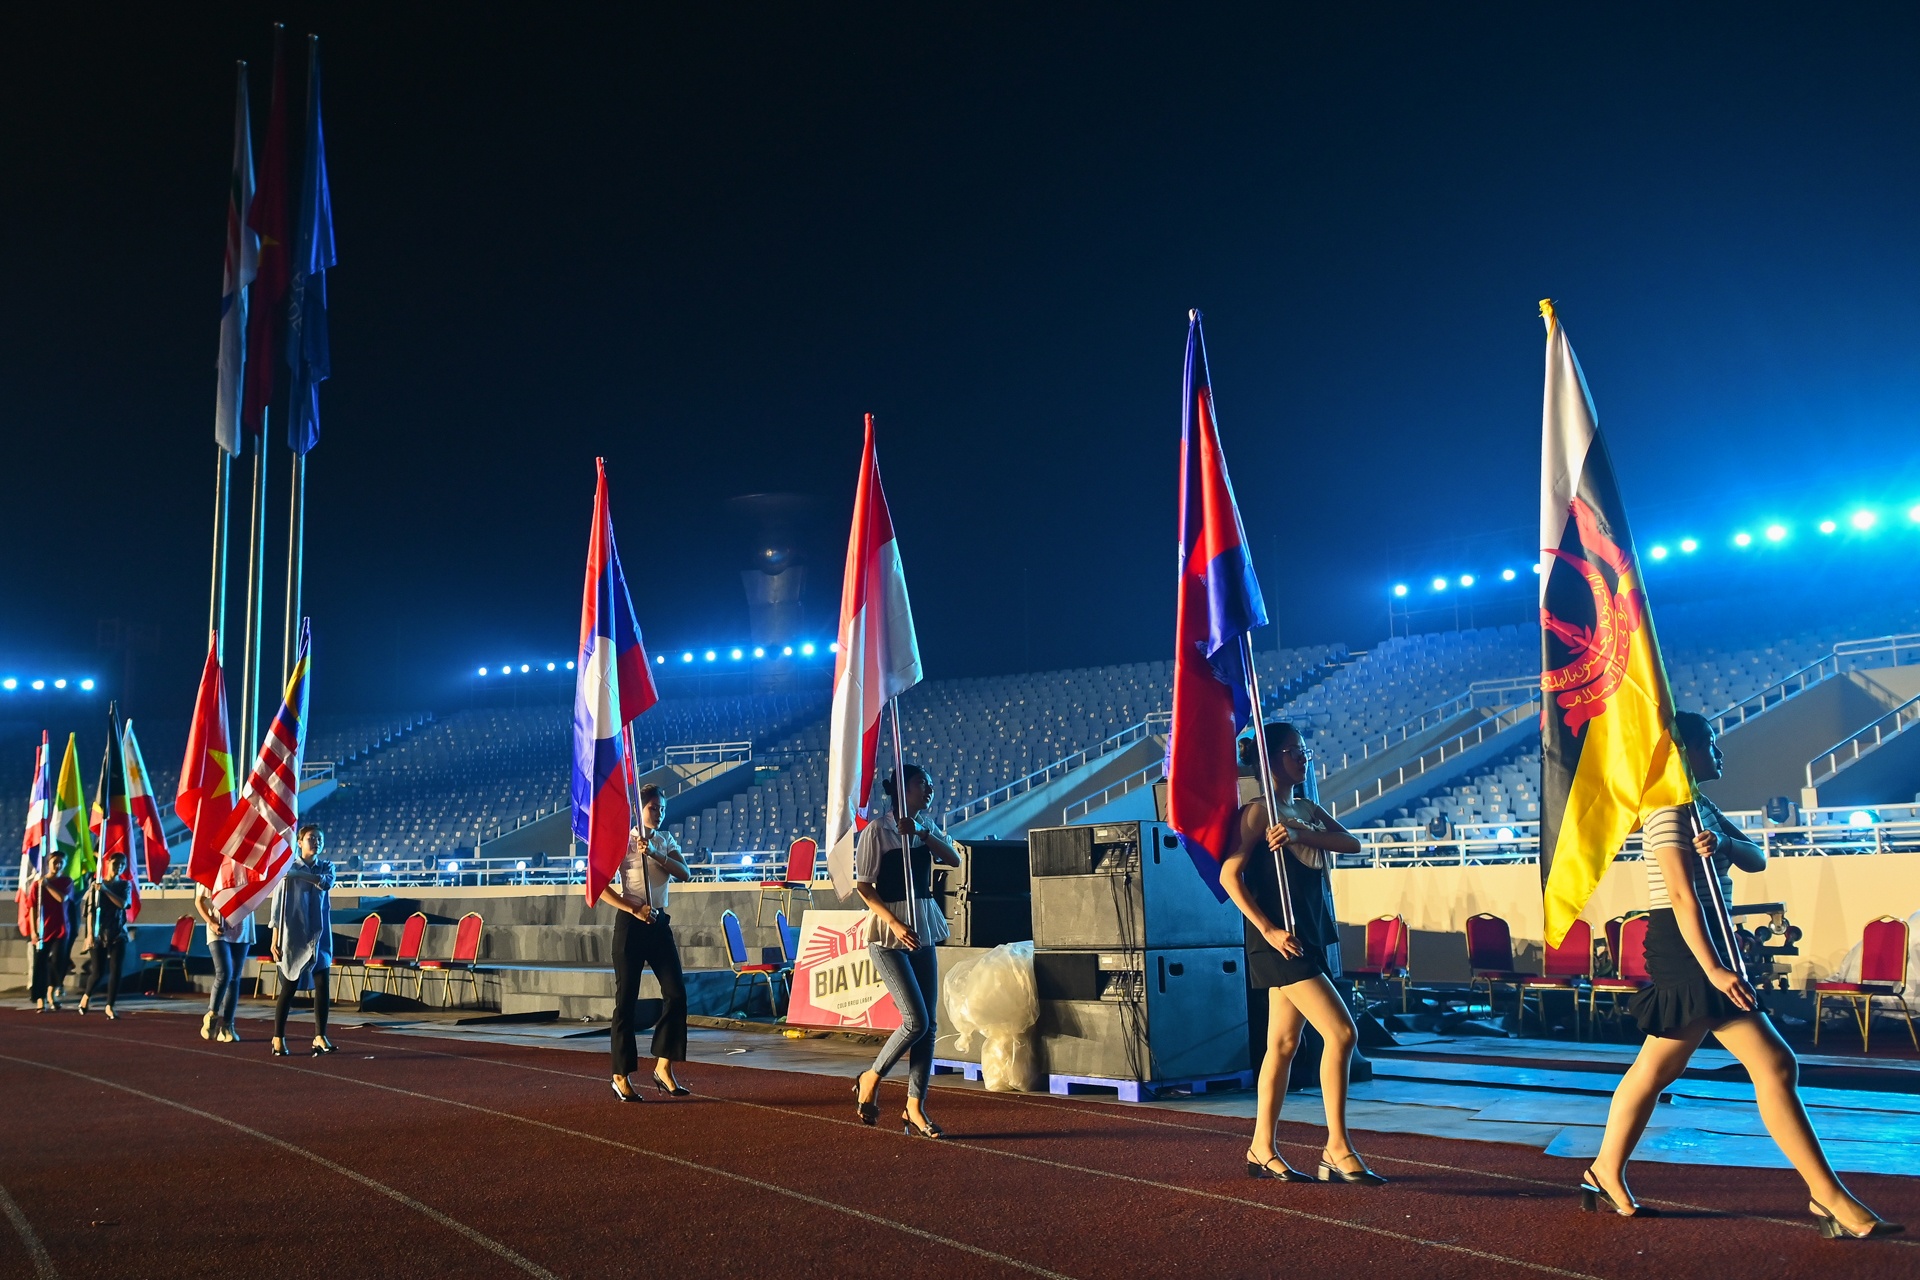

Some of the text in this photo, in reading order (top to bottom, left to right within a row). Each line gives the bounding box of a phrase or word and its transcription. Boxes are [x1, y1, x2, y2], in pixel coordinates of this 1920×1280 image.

[815, 964, 849, 998] BIA
[837, 1001, 847, 1009] COLD
[848, 998, 859, 1007] BREW
